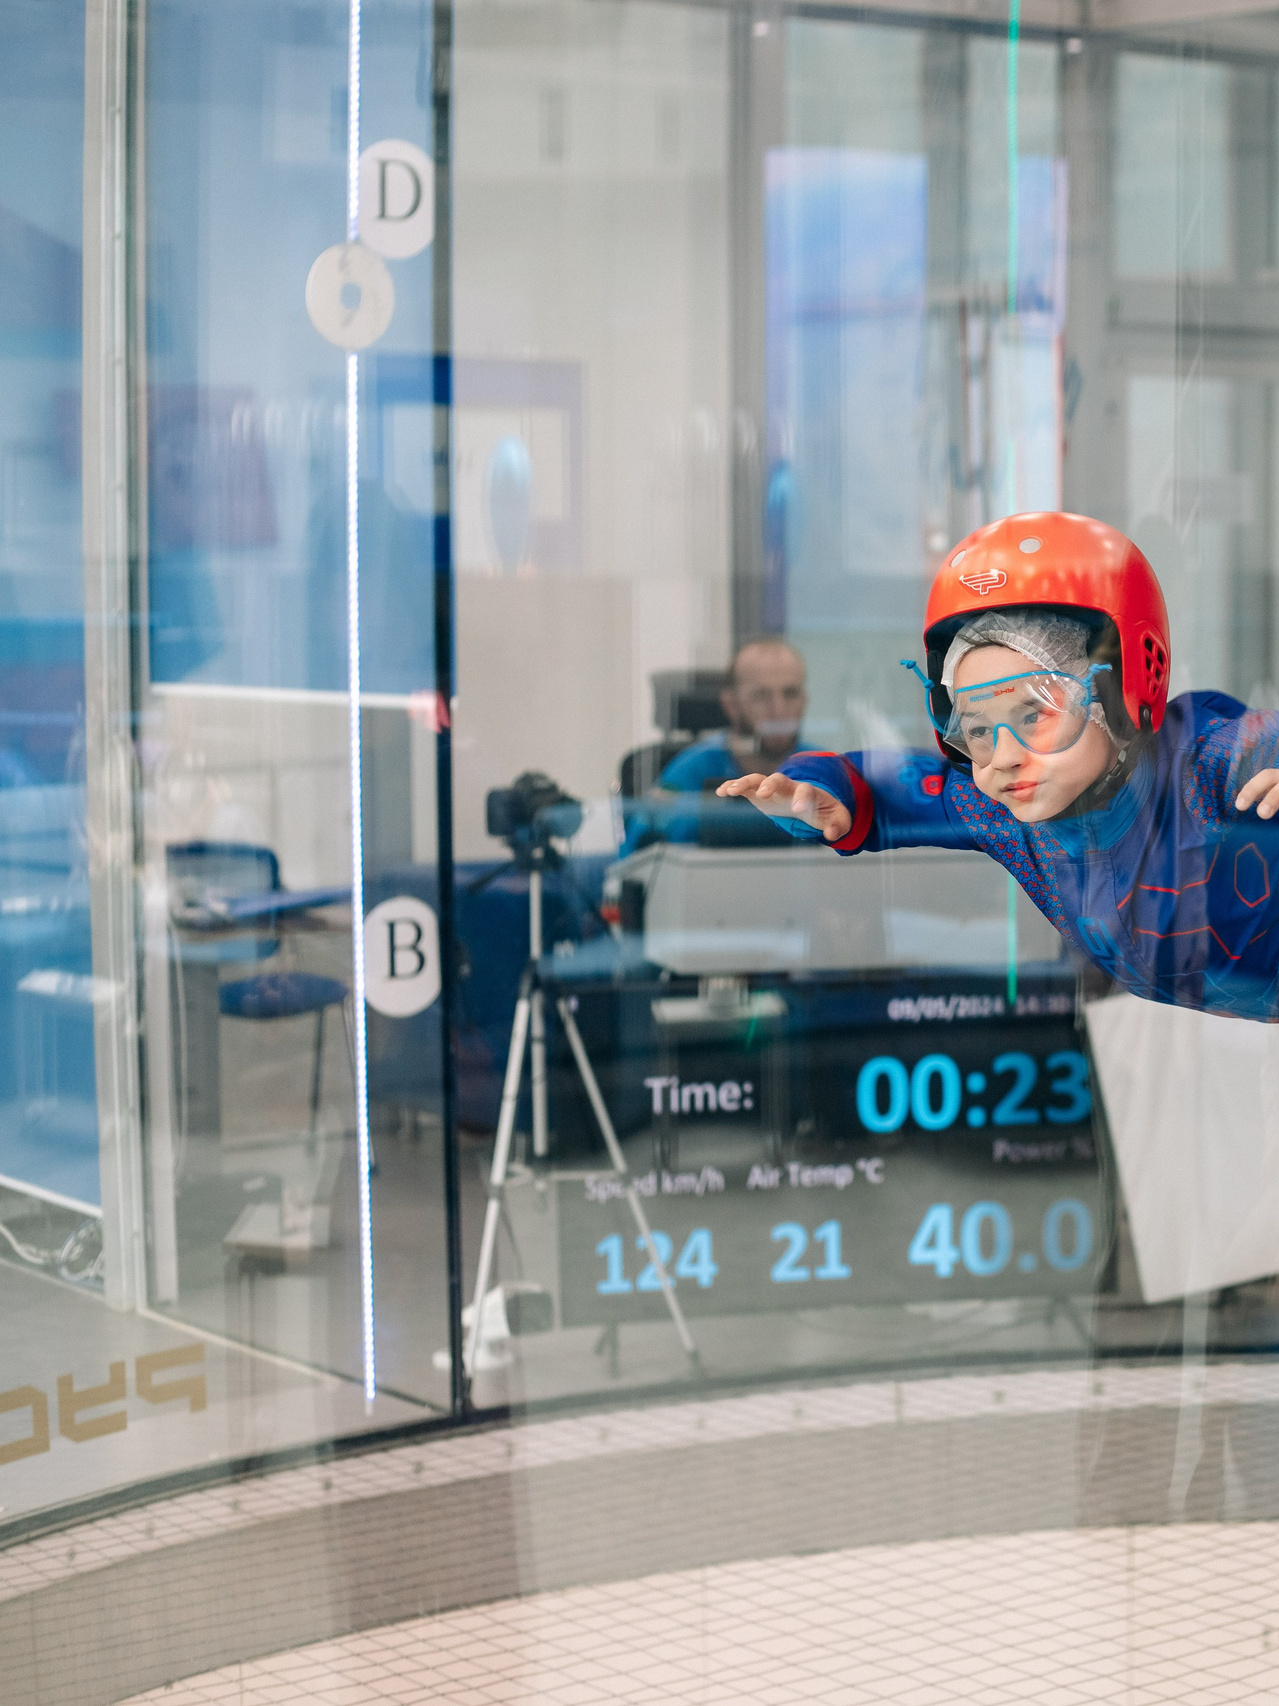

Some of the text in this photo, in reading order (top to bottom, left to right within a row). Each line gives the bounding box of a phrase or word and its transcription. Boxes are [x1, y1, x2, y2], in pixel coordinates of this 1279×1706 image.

[375, 158, 423, 222] D
[386, 917, 426, 980] B
[645, 1076, 753, 1114] Time:
[856, 1051, 1093, 1133] 00:23
[661, 1165, 725, 1197] km/h
[746, 1163, 780, 1190] Air
[786, 1160, 854, 1190] Temp
[596, 1227, 719, 1295] 124
[770, 1219, 852, 1284] 21
[908, 1198, 1094, 1278] 40.0
